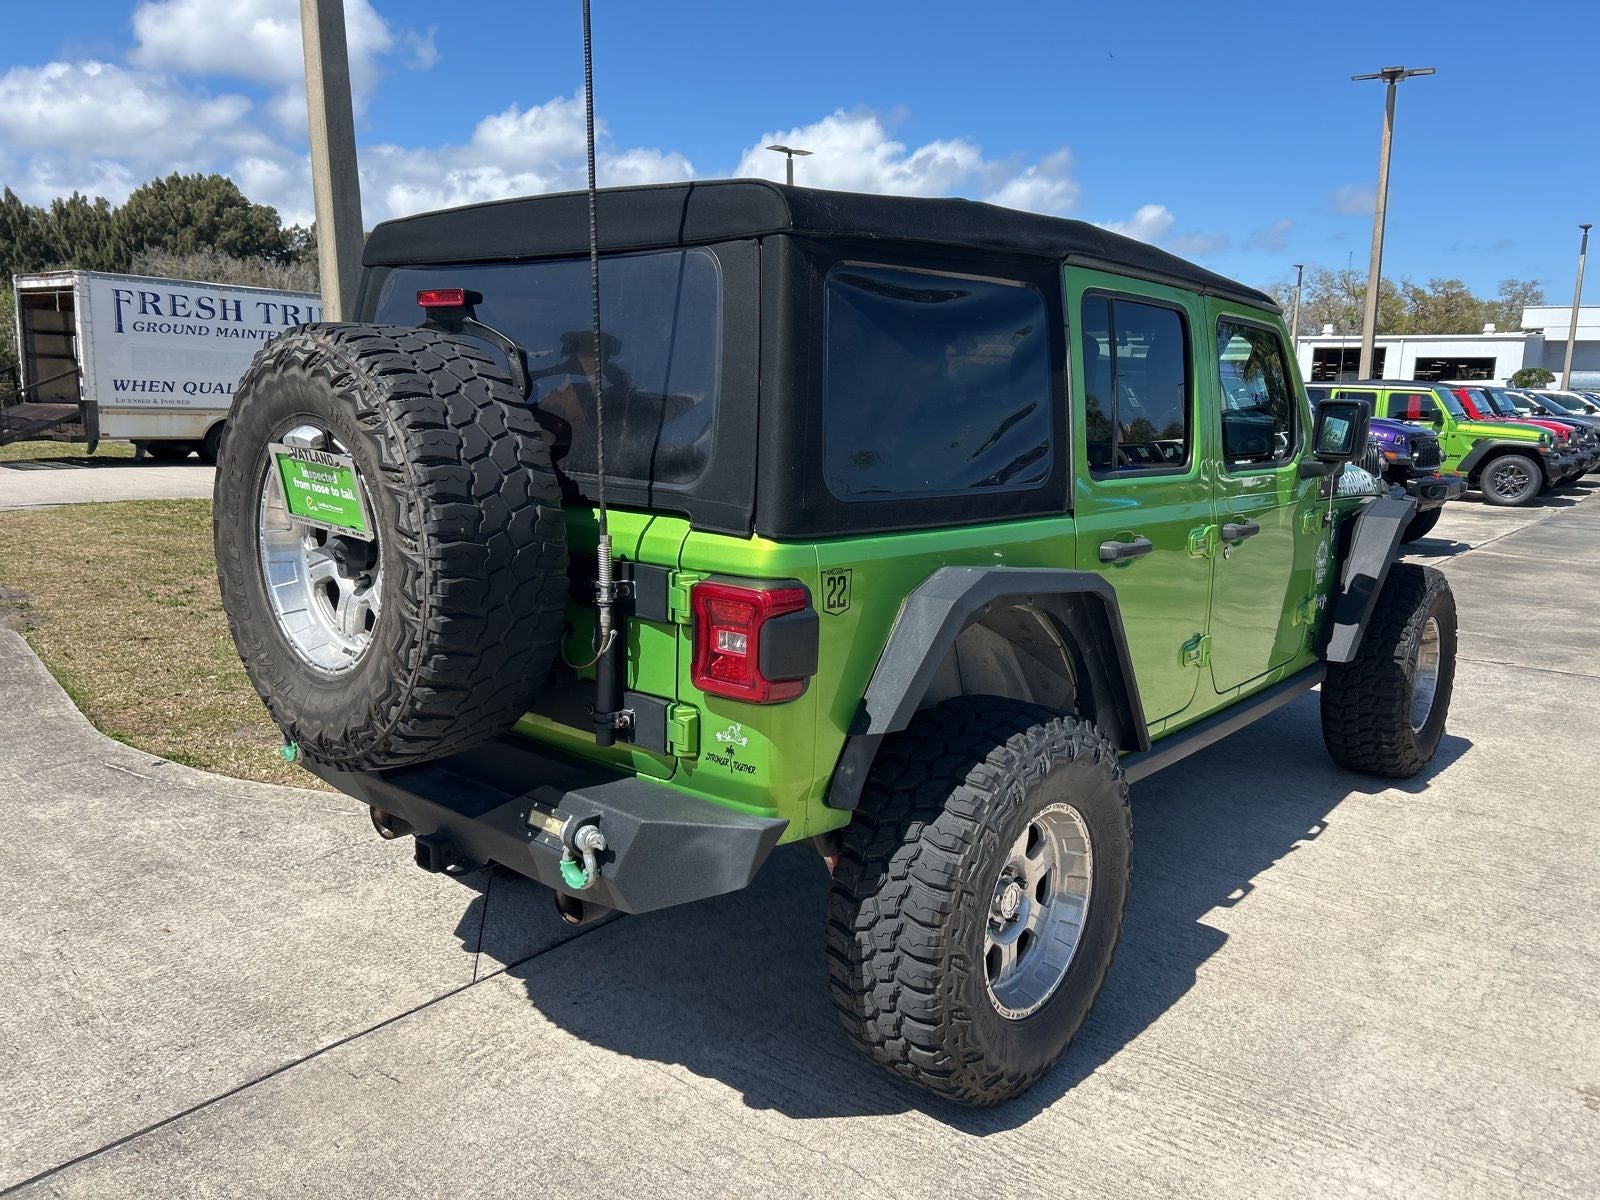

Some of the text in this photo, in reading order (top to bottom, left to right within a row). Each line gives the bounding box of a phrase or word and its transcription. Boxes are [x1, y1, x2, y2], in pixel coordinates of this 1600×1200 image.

[111, 288, 244, 334] FRESH
[132, 321, 210, 336] GROUND
[112, 379, 176, 393] WHEN
[301, 466, 338, 484] Inspected
[293, 477, 357, 501] from nose to tail.
[826, 575, 847, 609] 22
[705, 752, 757, 775] STRONGER TOGETHER
